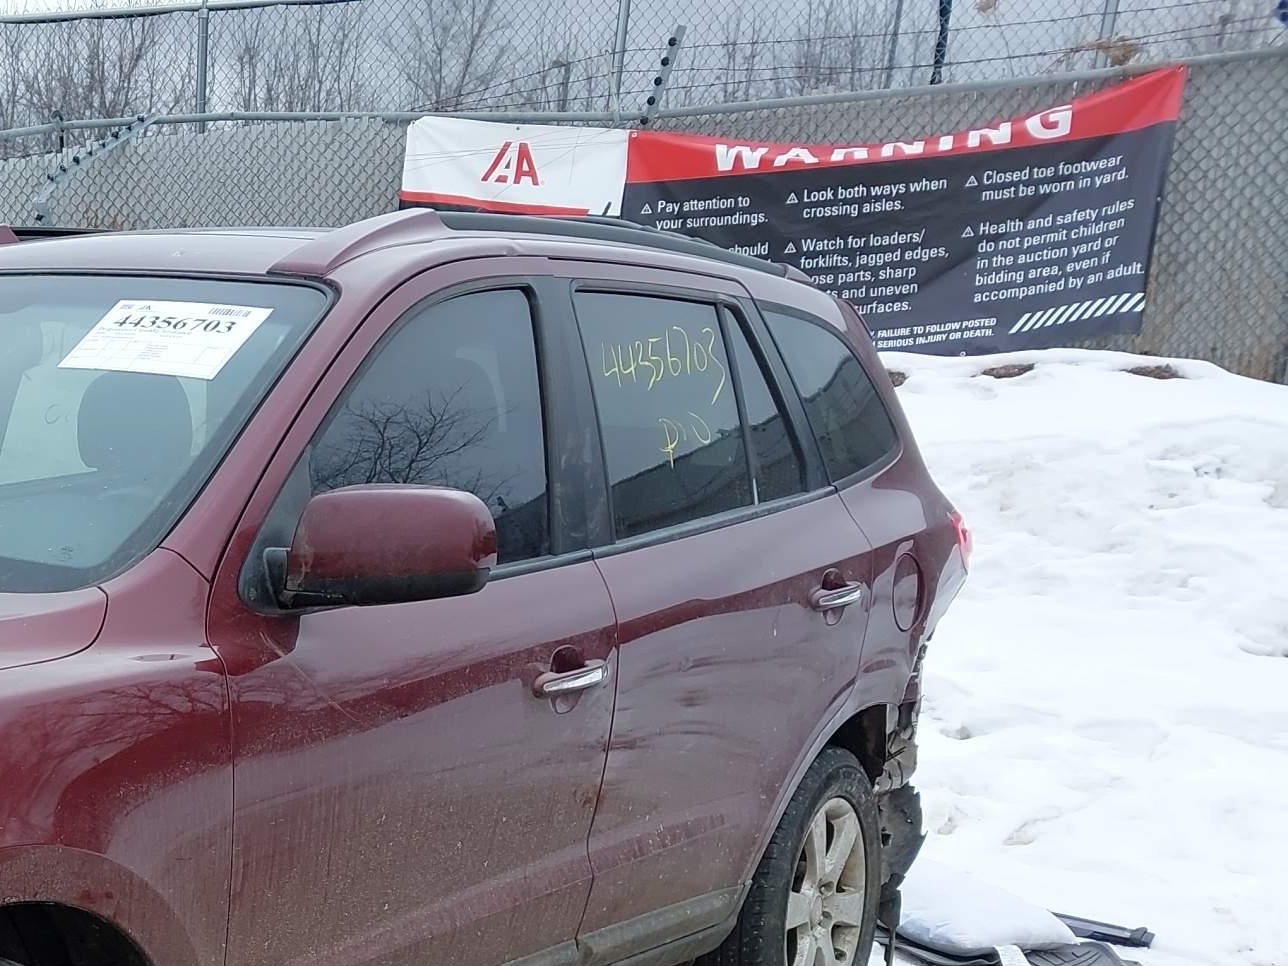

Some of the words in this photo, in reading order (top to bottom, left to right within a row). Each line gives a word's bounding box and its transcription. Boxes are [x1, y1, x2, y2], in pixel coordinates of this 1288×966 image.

[983, 166, 1030, 185] Closed
[1032, 166, 1055, 179] toe
[1059, 154, 1123, 176] footwear
[803, 186, 834, 203] Look
[838, 183, 867, 199] both
[870, 182, 906, 198] ways
[909, 177, 948, 193] when
[982, 186, 1016, 201] must
[1019, 184, 1035, 197] be
[1039, 180, 1075, 195] worn
[1078, 176, 1091, 189] in
[1095, 167, 1129, 188] yard.
[657, 200, 680, 216] Pay
[683, 196, 736, 212] attention
[737, 196, 751, 209] to
[803, 201, 859, 219] crossing
[862, 198, 906, 213] aisles.
[979, 218, 1023, 236] Health
[1027, 214, 1053, 230] and
[1056, 207, 1099, 226] safety
[1101, 198, 1135, 216] rules
[656, 218, 683, 231] your
[686, 211, 769, 229] surroundings.
[801, 235, 844, 252] Watch
[847, 234, 867, 249] for
[870, 228, 926, 246] loaders/
[978, 239, 995, 253] do
[998, 236, 1021, 251] not
[1024, 230, 1068, 251] permit
[1071, 217, 1125, 239] children
[800, 254, 853, 270] forklifts,
[855, 251, 901, 268] jagged
[904, 246, 950, 262] edges,
[976, 256, 989, 270] in
[992, 251, 1014, 267] the
[1017, 246, 1068, 264] auction
[1072, 238, 1101, 258] yard
[1104, 234, 1119, 247] or
[811, 273, 834, 286] ose
[838, 270, 875, 287] parts,
[878, 266, 917, 283] sharp
[975, 270, 1024, 287] bidding
[1028, 264, 1062, 280] area,
[1066, 258, 1099, 273] even
[1101, 250, 1112, 265] if
[841, 285, 866, 299] and
[870, 283, 918, 298] uneven
[974, 279, 1065, 303] accompanied
[1068, 275, 1084, 290] by
[1087, 271, 1103, 285] an
[1106, 261, 1145, 281] adult.
[855, 301, 913, 316] urfaces.
[113, 314, 237, 334] 44356703
[877, 327, 912, 338] FAILURE
[913, 326, 924, 335] TO
[925, 321, 962, 333] FOLLOW
[962, 317, 997, 329] POSTED
[877, 338, 914, 348] SERIOUS
[915, 333, 948, 345] INJURY
[949, 331, 962, 340] OR
[962, 328, 995, 339] DEATH.
[601, 325, 726, 405] 44356703
